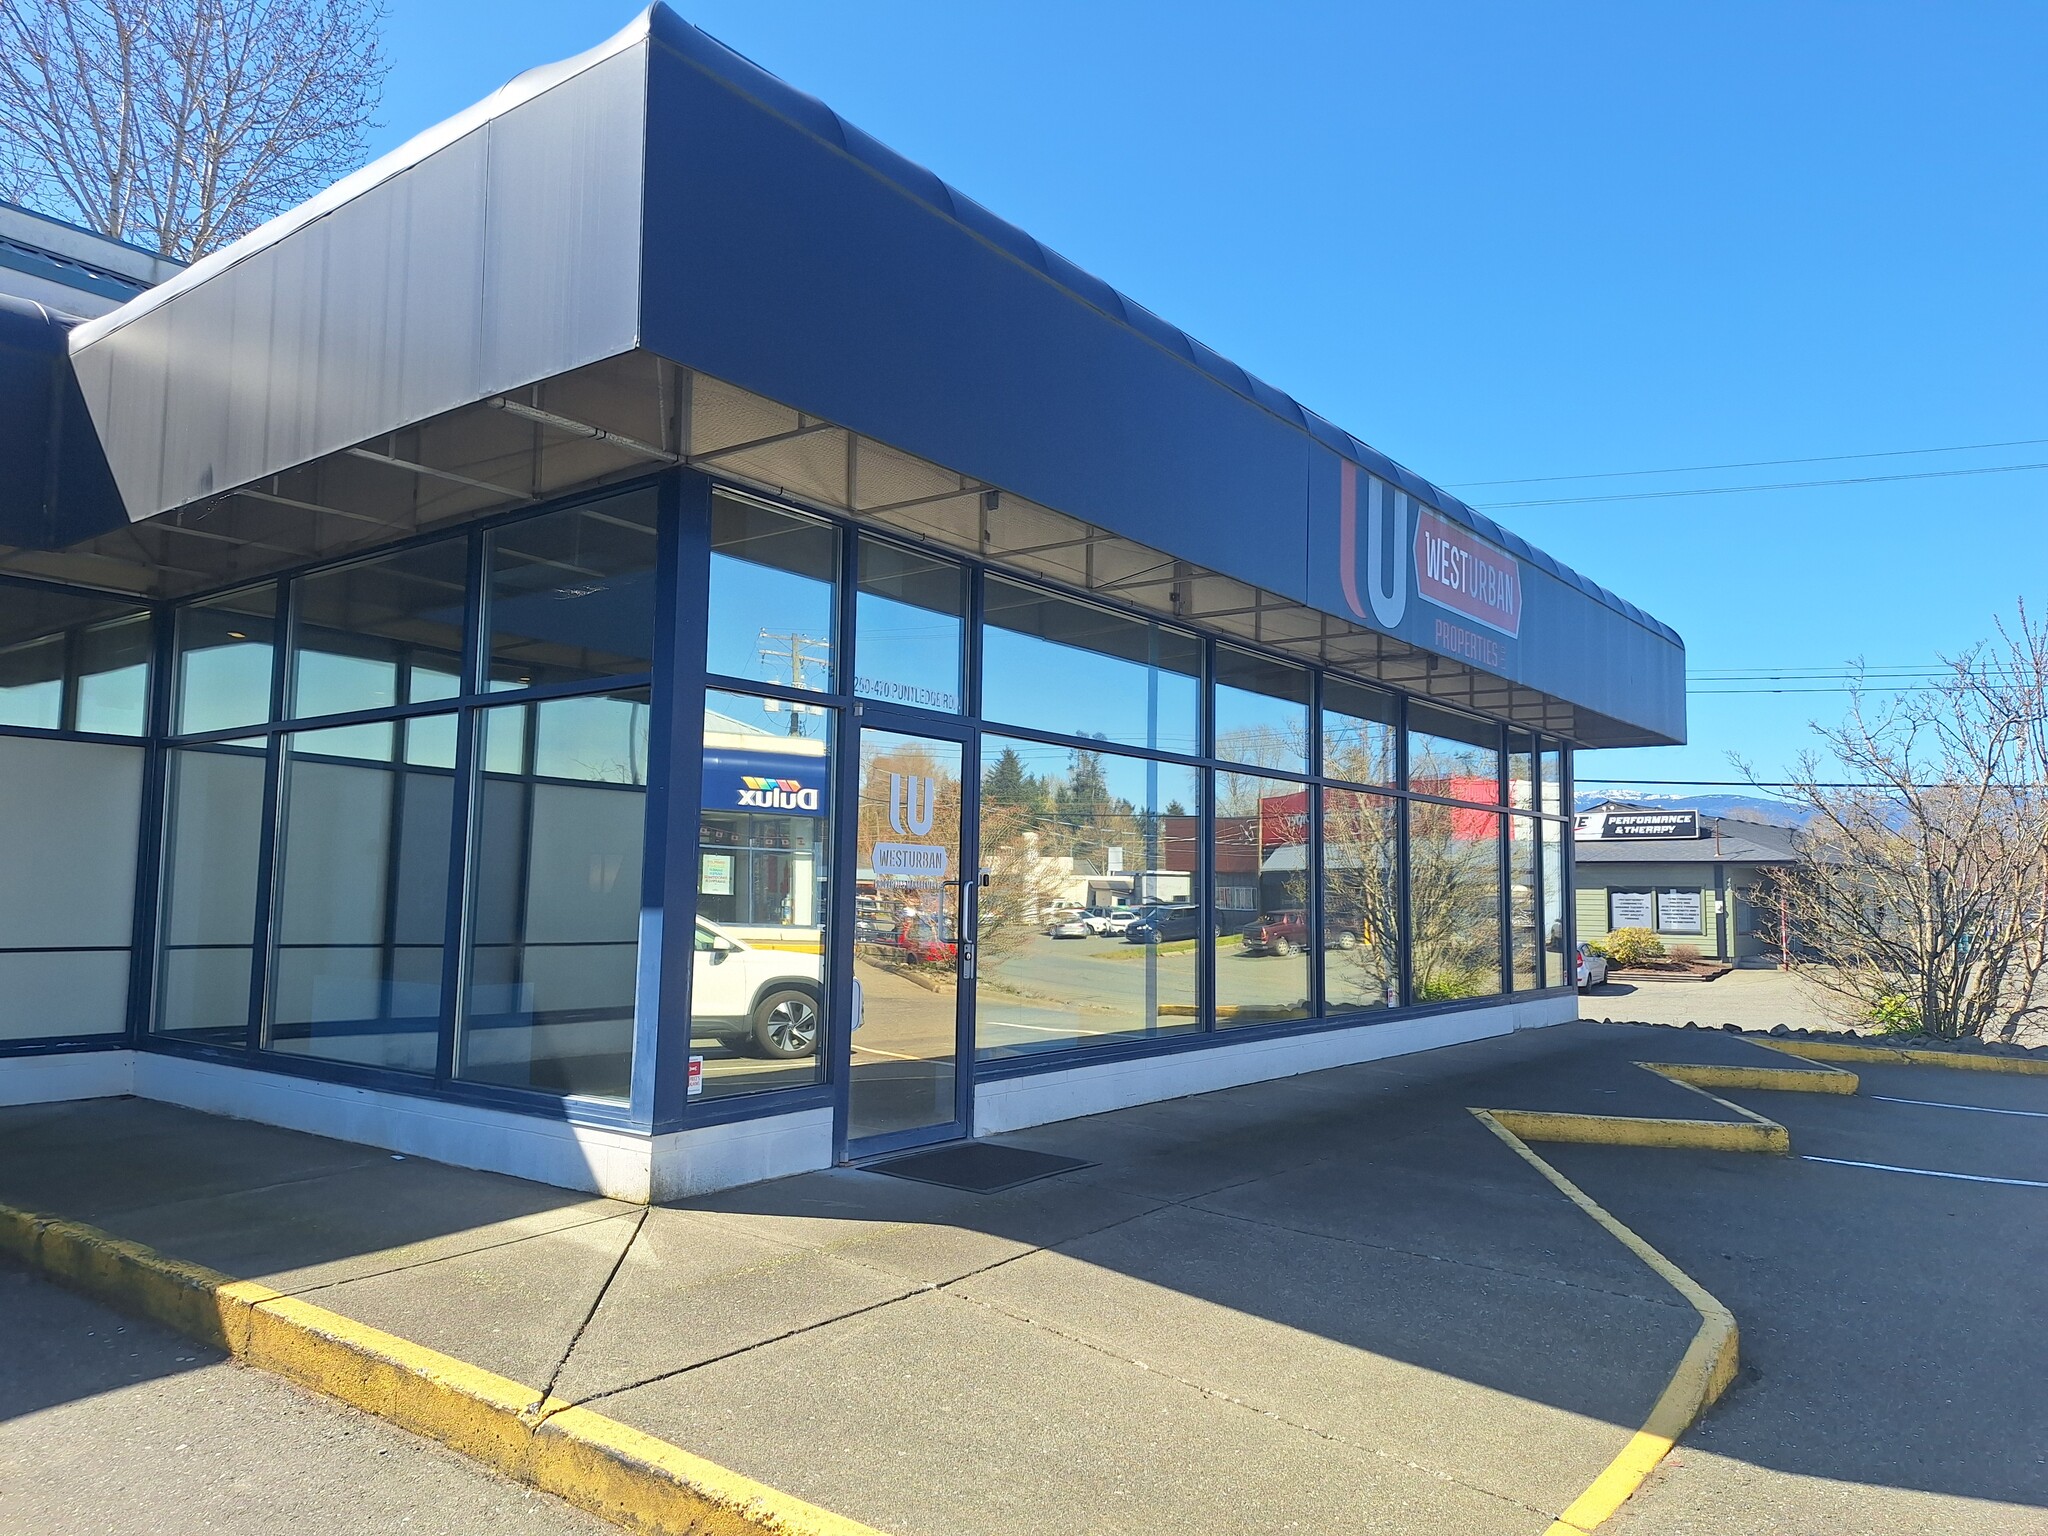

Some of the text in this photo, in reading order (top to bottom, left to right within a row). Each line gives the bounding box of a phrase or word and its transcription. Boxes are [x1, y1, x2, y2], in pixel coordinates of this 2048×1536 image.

[1425, 531, 1513, 615] WESTURBAN
[1435, 619, 1498, 667] PROPERTIES
[1608, 815, 1692, 825] PERFORMANCE
[880, 849, 942, 869] WESTURBAN
